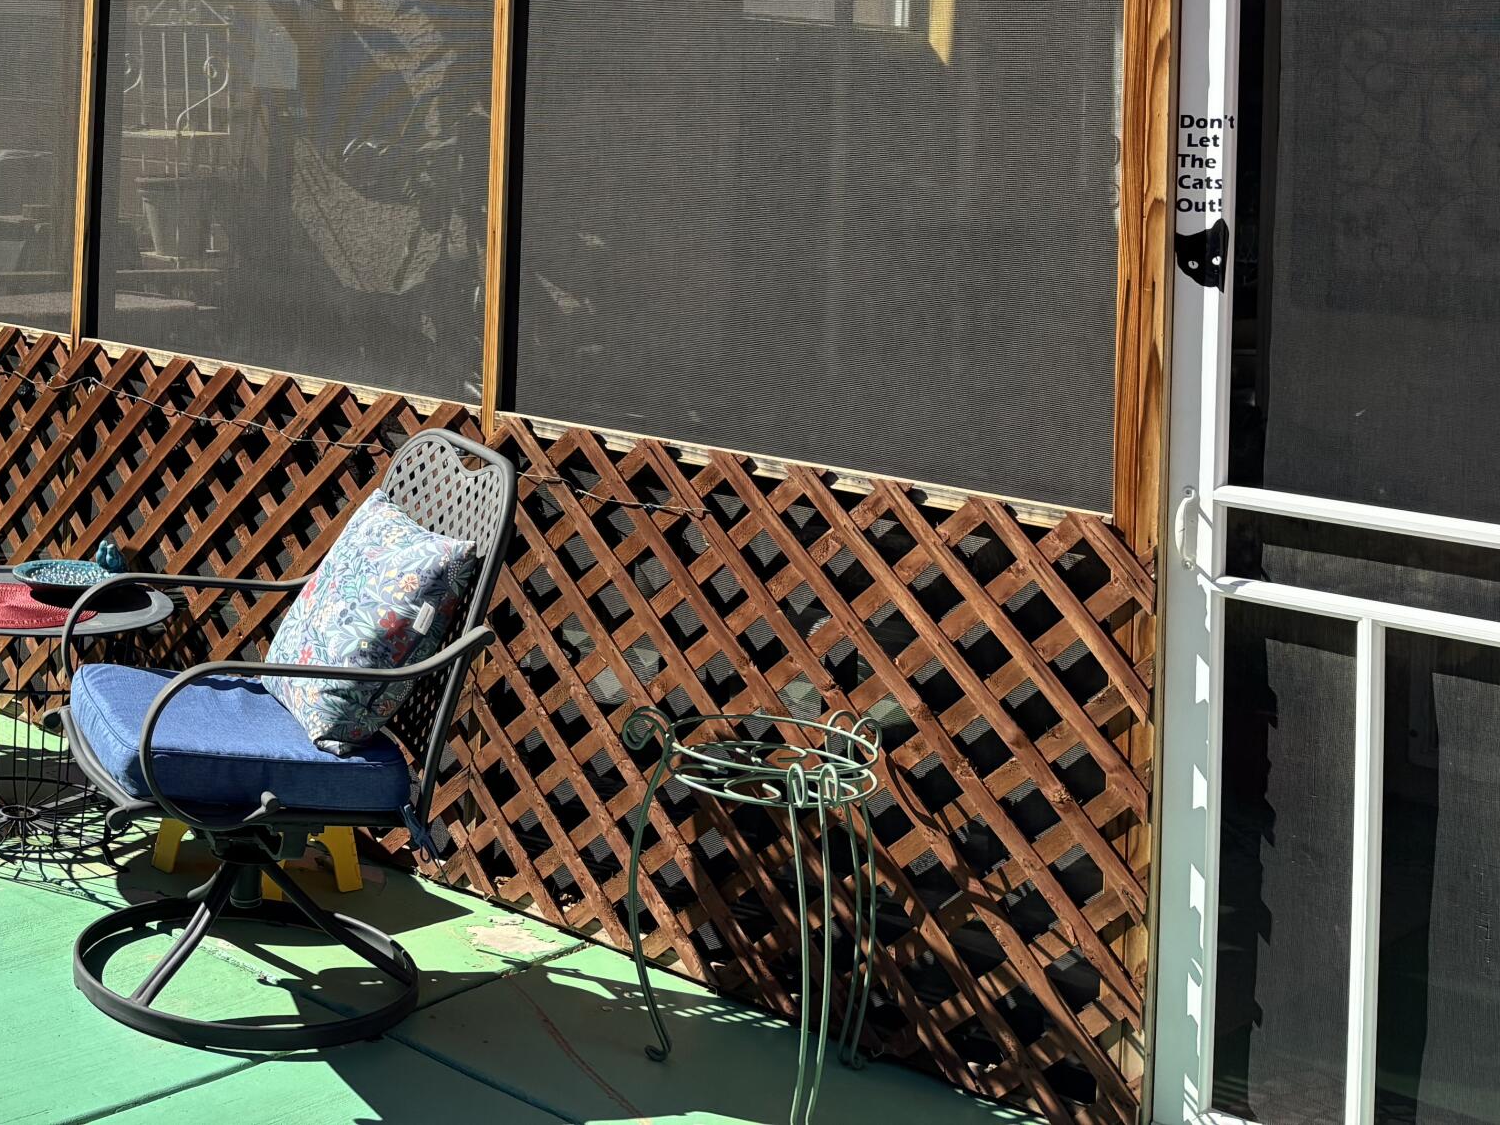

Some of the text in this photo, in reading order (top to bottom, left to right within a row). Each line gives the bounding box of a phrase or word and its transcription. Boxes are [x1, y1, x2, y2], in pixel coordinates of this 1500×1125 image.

[1180, 114, 1235, 129] Don't
[1187, 133, 1220, 148] Let
[1178, 154, 1217, 169] The
[1178, 175, 1223, 190] Cats
[1176, 198, 1223, 213] Out!
